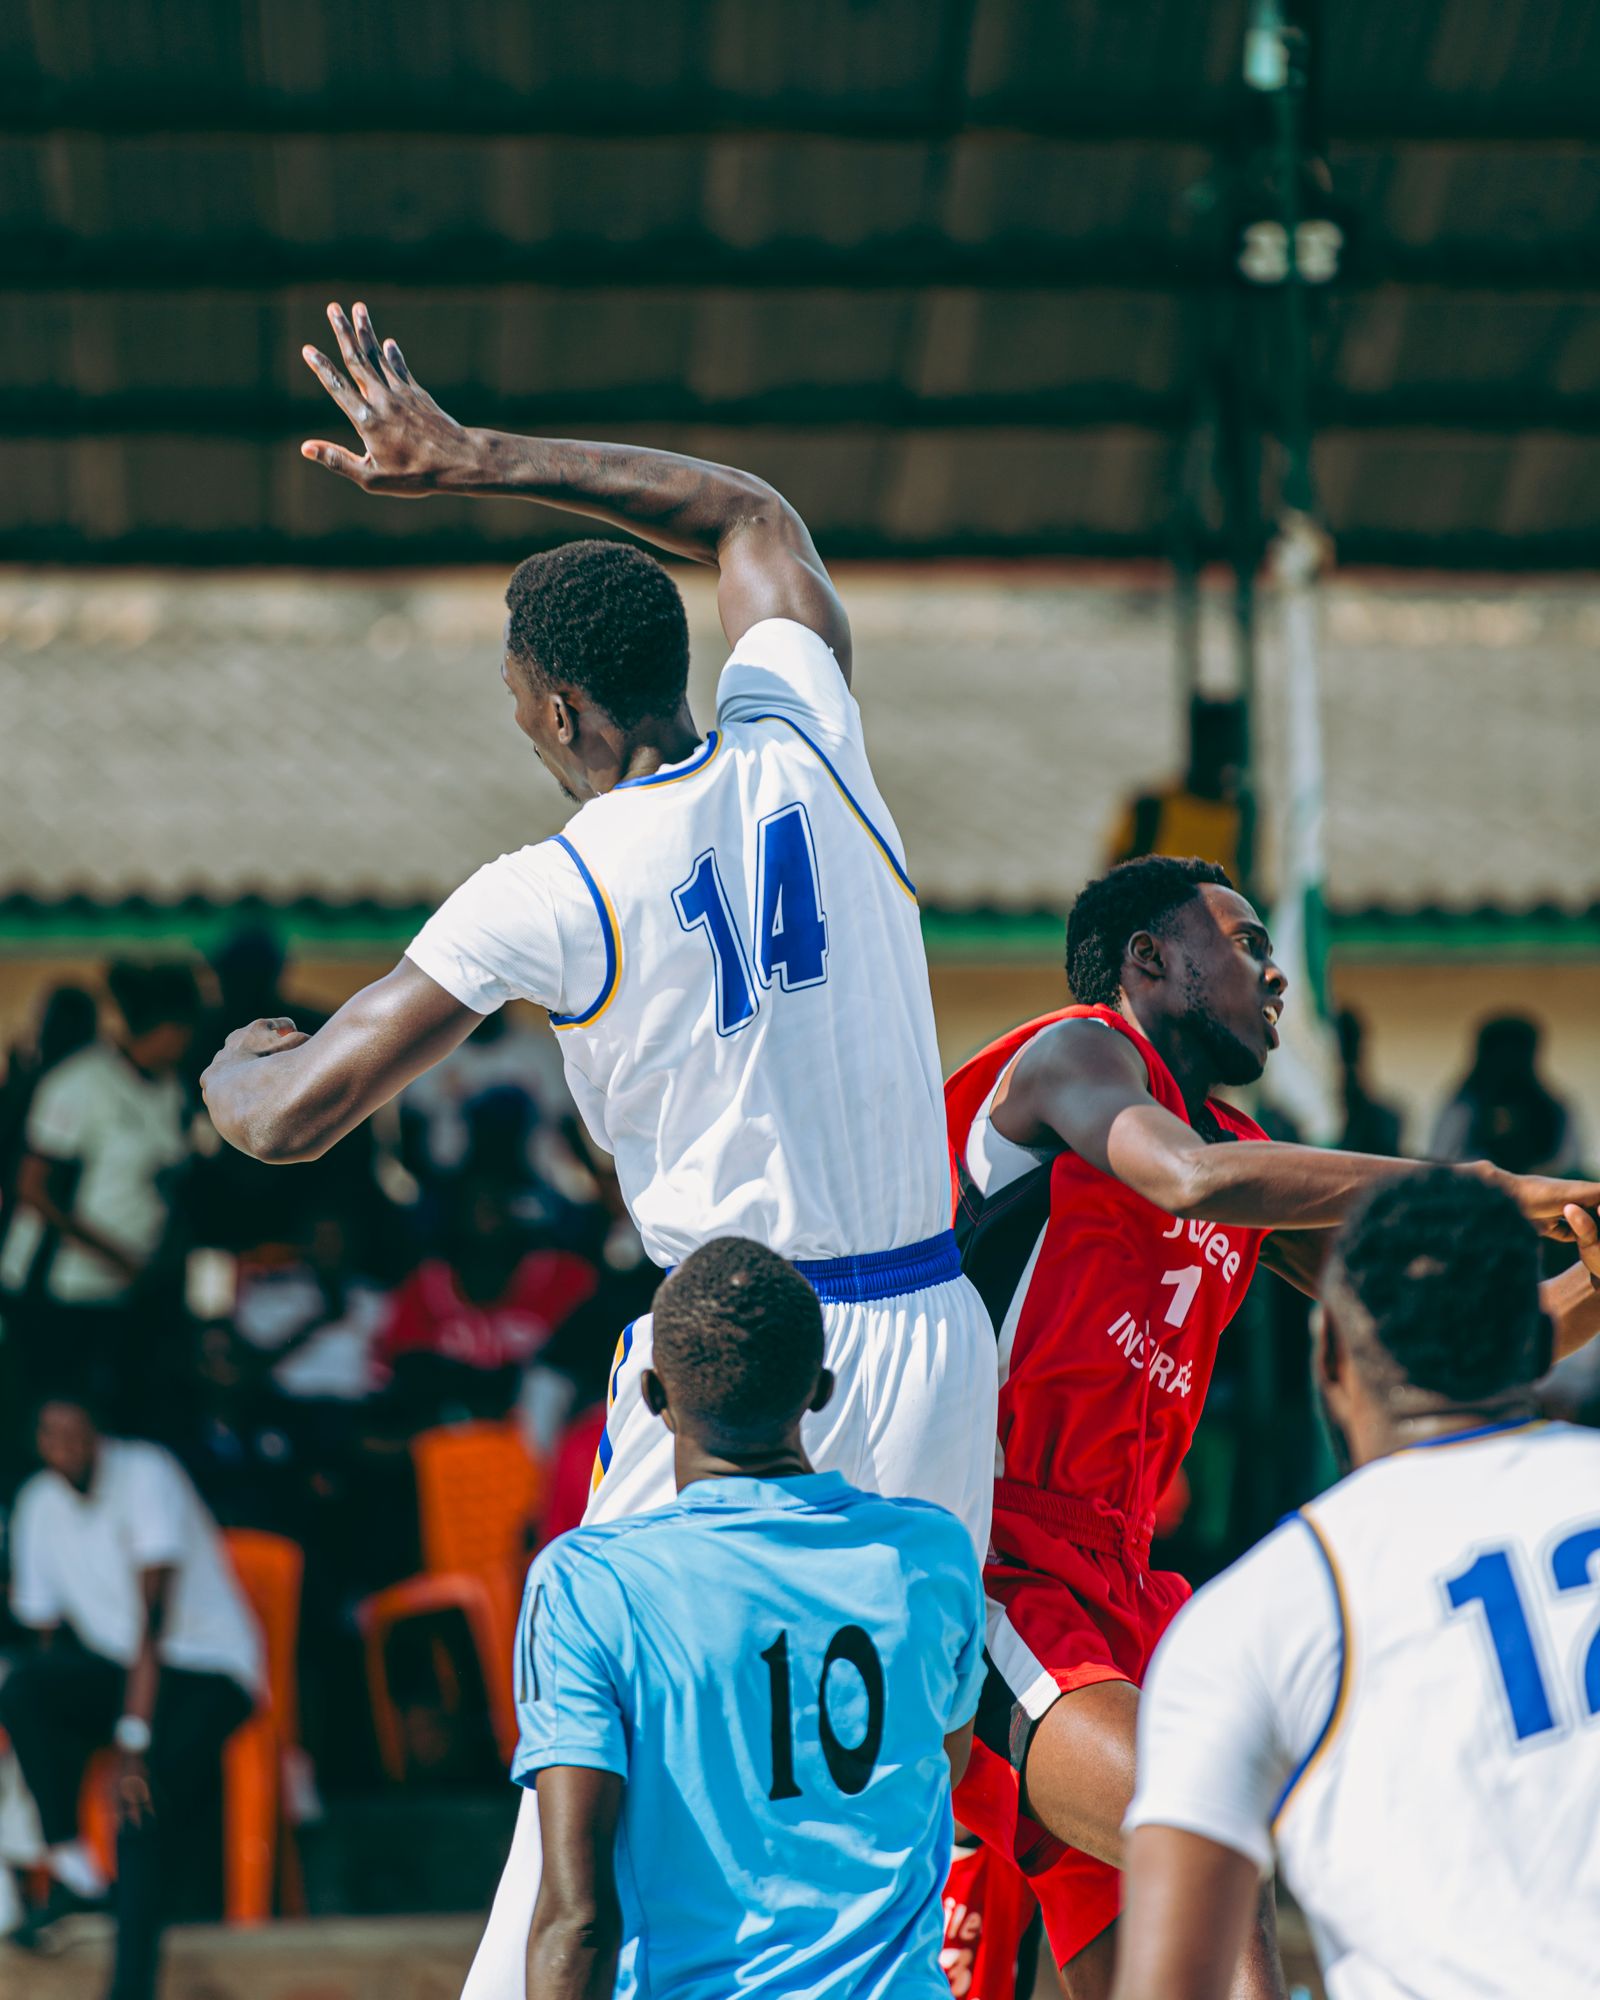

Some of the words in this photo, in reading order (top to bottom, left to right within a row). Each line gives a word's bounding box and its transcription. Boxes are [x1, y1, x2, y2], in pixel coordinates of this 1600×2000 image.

[670, 801, 830, 1038] 14
[1160, 1264, 1202, 1328] 1
[760, 1624, 885, 1801] 10
